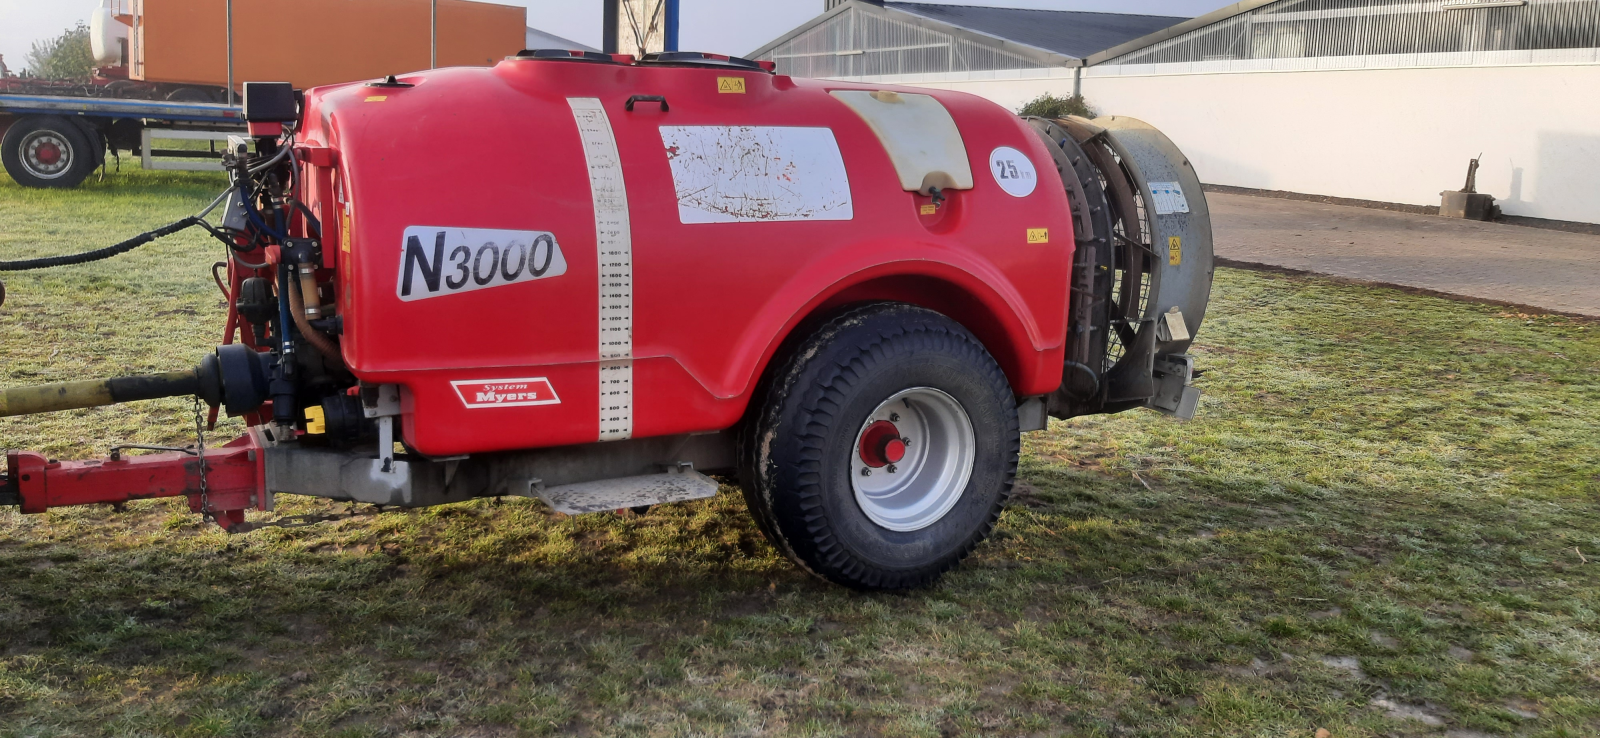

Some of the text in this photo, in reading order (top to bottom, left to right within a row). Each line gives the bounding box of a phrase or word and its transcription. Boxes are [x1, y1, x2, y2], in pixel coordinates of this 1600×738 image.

[996, 160, 1019, 180] 25
[401, 231, 554, 296] N3000
[483, 384, 528, 392] System
[476, 391, 537, 403] Myers
